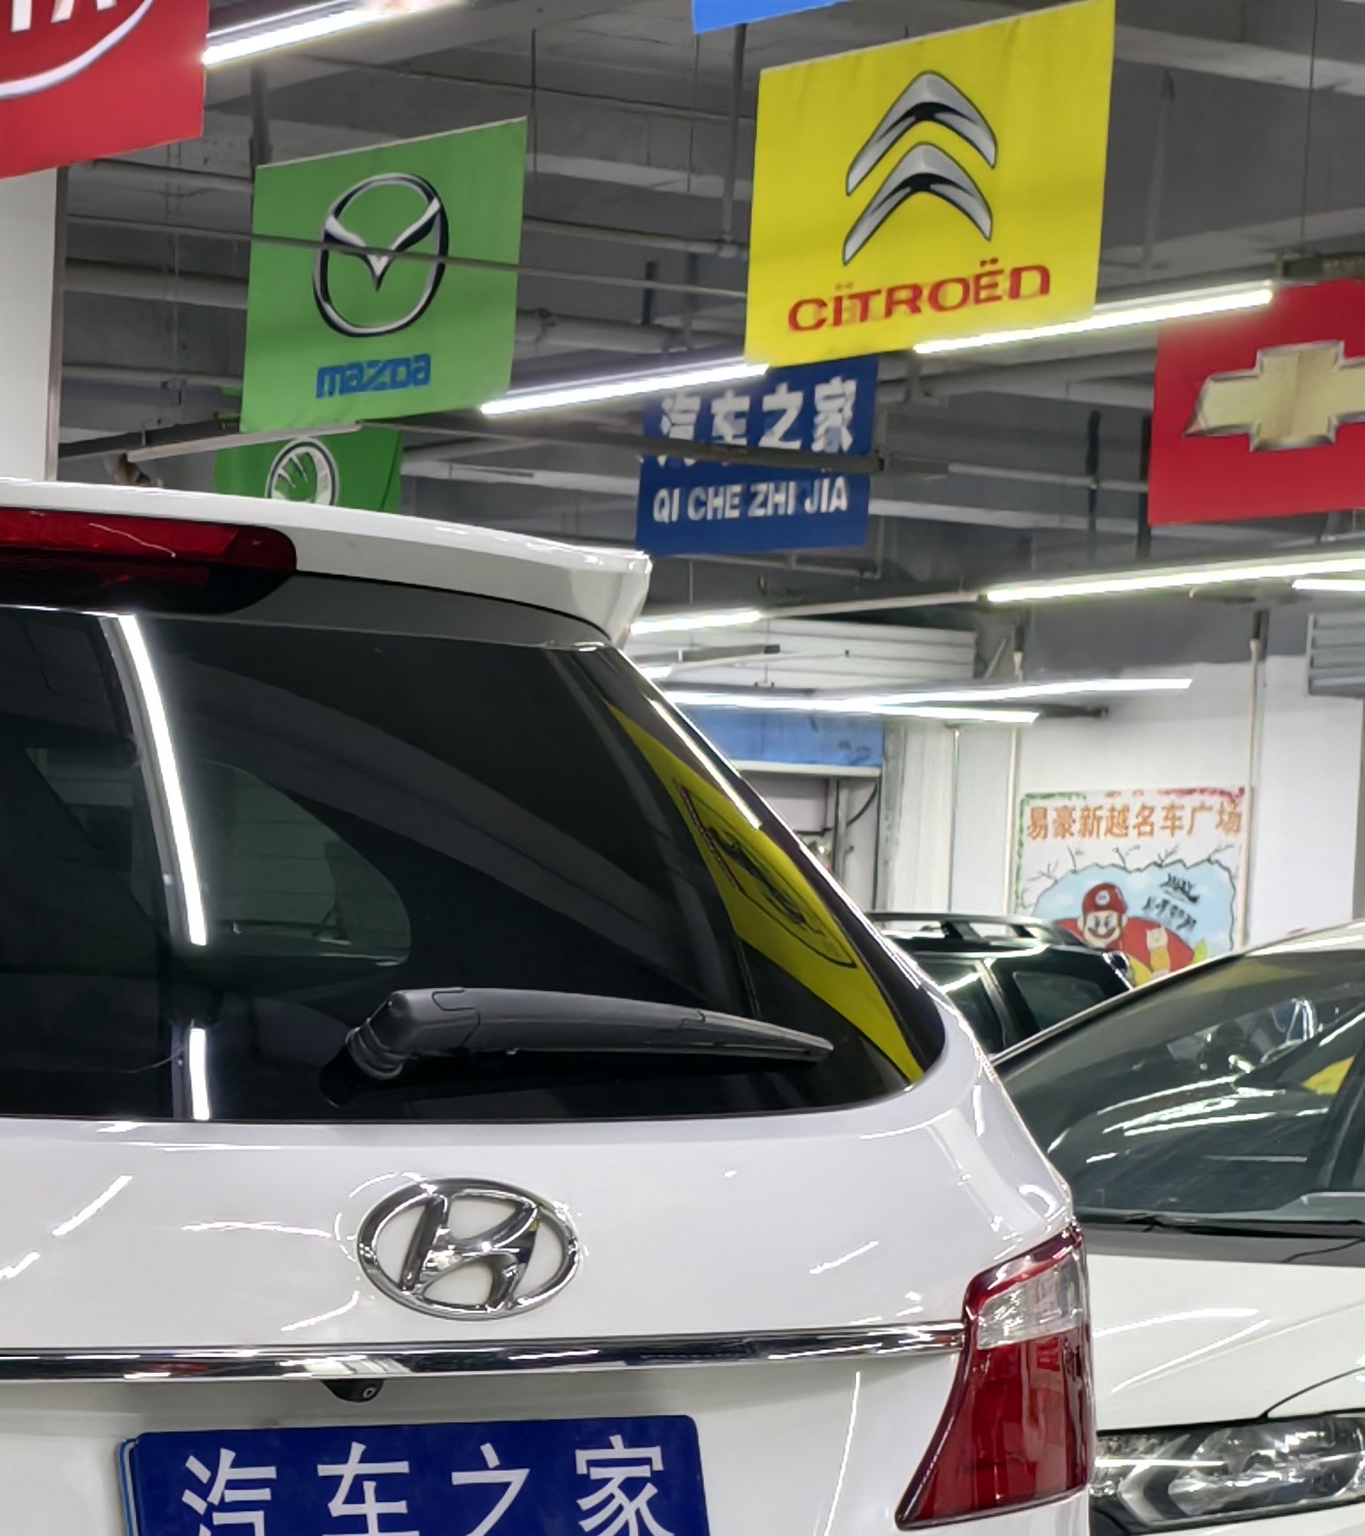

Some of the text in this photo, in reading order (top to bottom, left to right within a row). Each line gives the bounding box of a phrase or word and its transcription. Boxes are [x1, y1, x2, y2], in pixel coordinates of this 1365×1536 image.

[657, 376, 857, 467] 汽车之家
[653, 476, 848, 523] QI CHE ZHI JIA
[1027, 801, 1243, 840] 易豪新越名车广场
